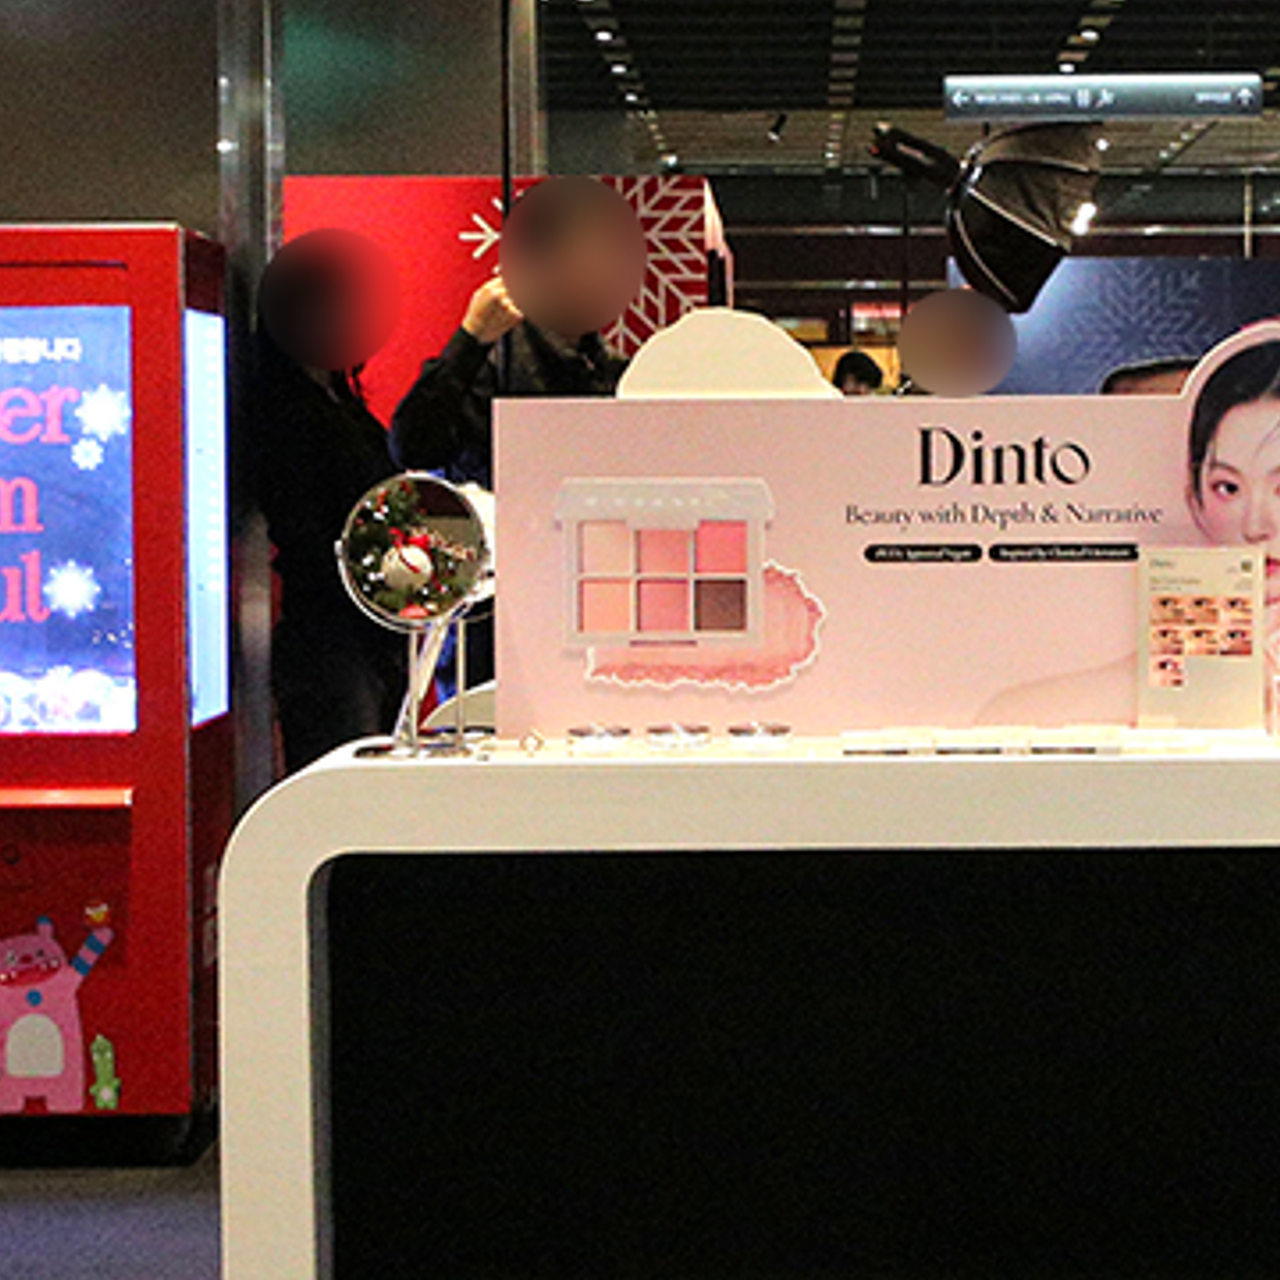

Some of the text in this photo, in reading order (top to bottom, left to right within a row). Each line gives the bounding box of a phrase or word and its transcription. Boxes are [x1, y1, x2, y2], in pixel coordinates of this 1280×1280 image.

[918, 426, 1091, 486] Dinto
[846, 502, 1163, 531] Beauty with Depth & Narrative
